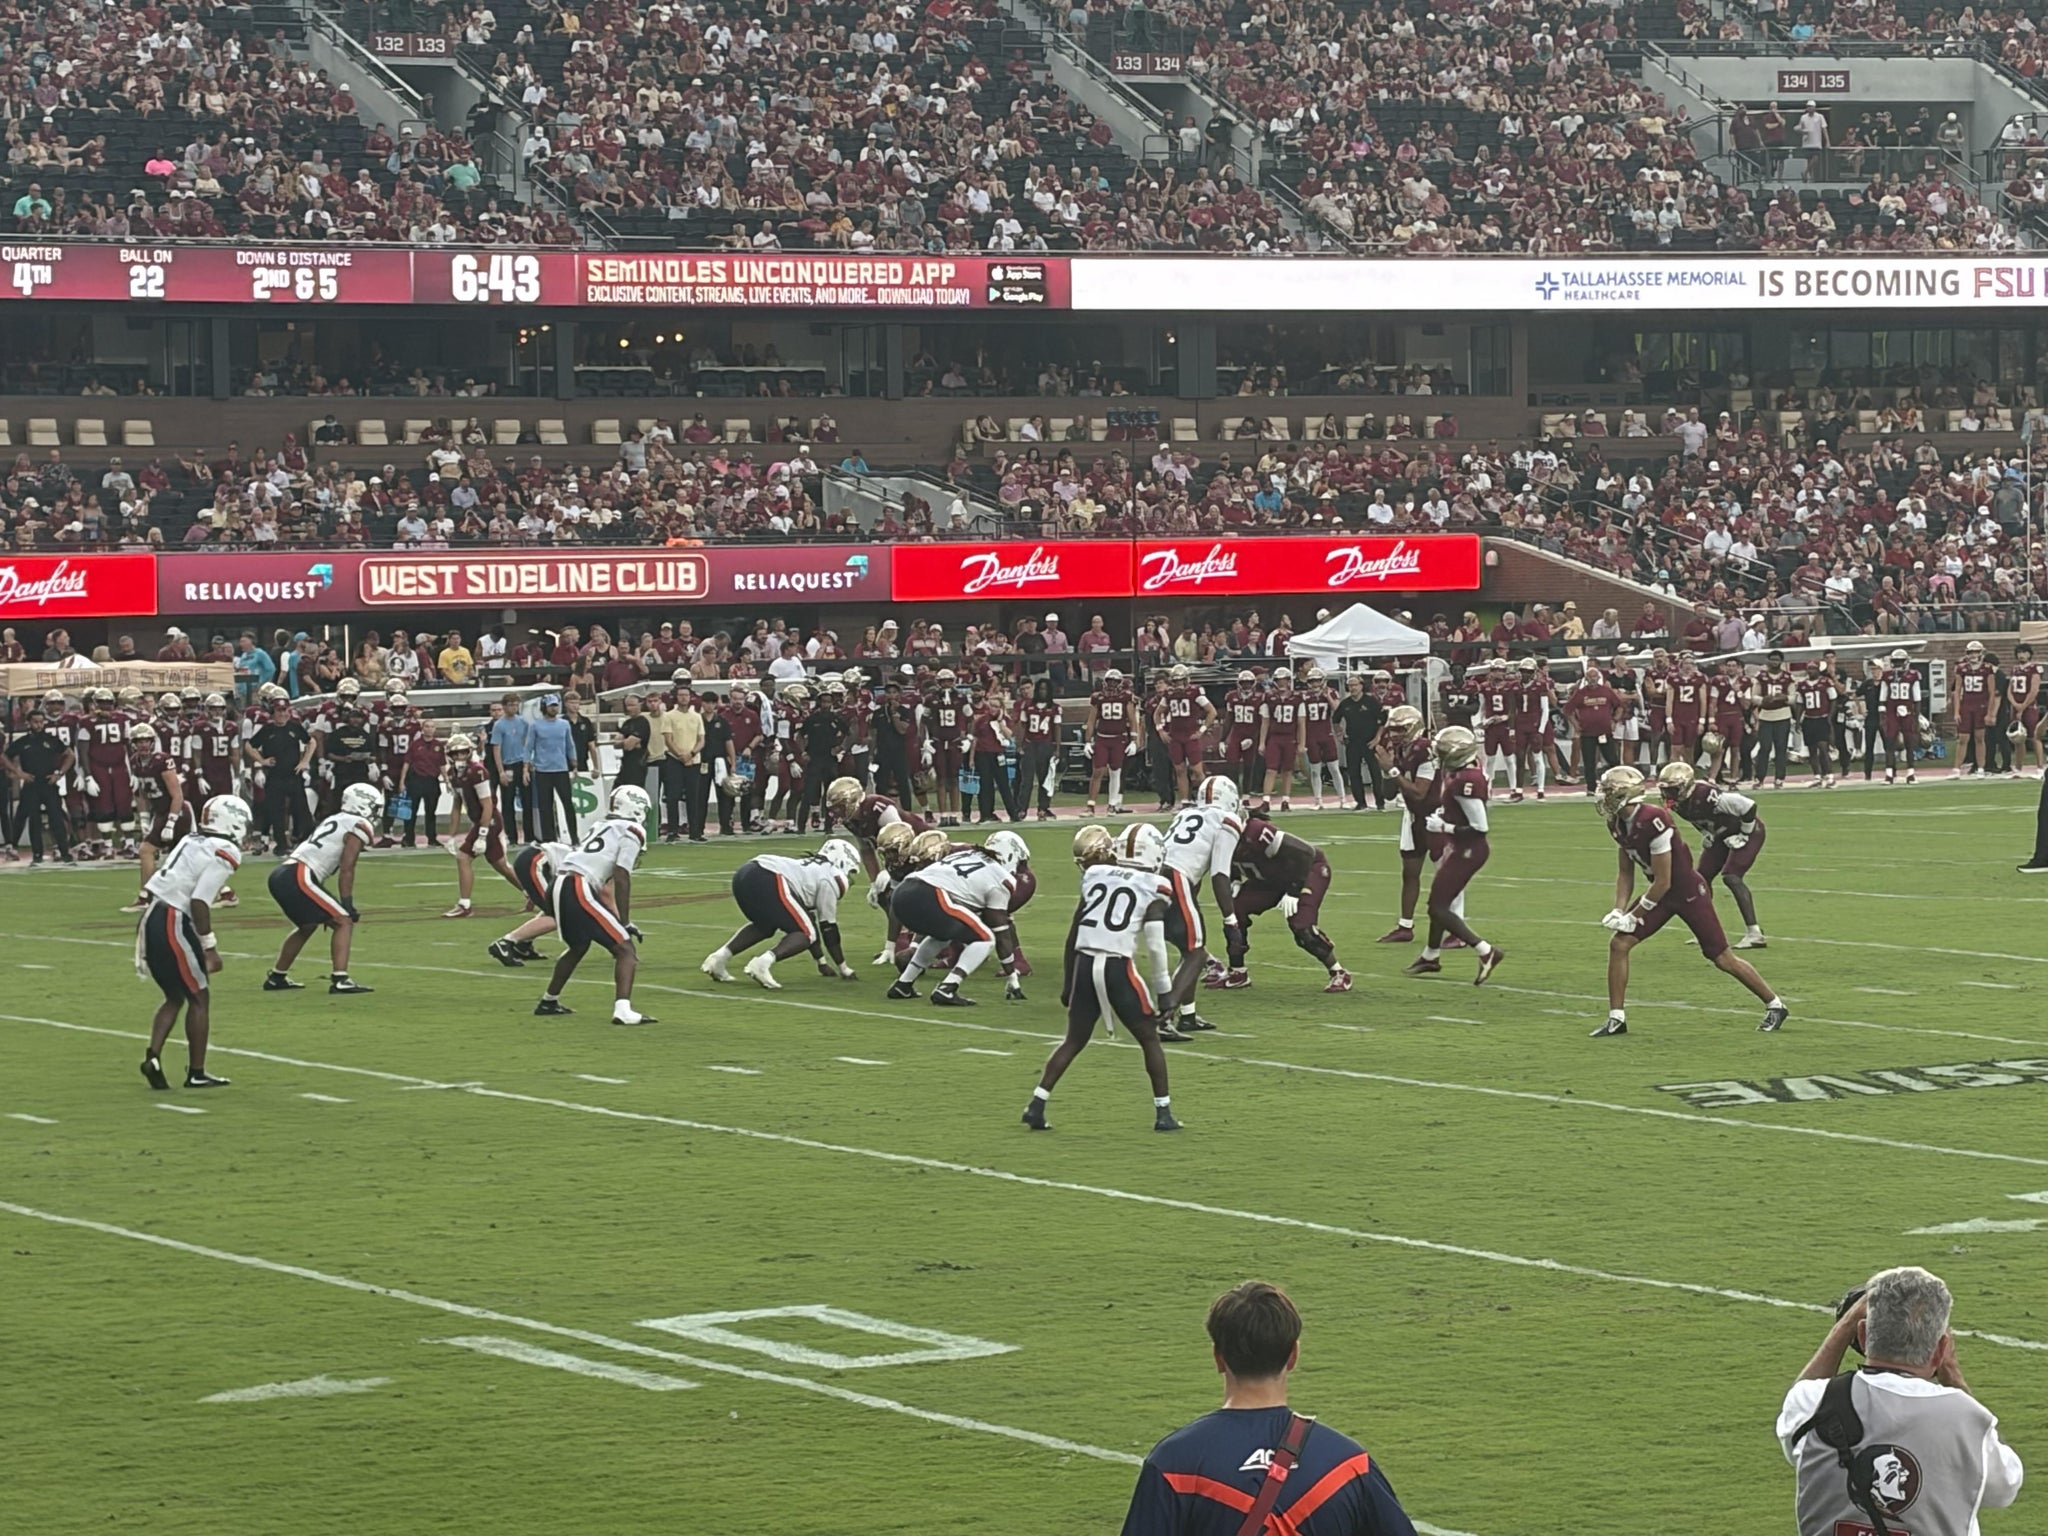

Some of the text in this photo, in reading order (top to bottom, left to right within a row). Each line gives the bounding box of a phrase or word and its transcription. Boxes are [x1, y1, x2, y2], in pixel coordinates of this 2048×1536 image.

[375, 36, 404, 52] 132
[417, 38, 446, 53] 133
[1115, 56, 1142, 71] 133
[1154, 56, 1181, 71] 134
[1782, 74, 1808, 88] 134
[1819, 74, 1846, 89] 135
[2, 246, 62, 262] QUARTER
[119, 249, 173, 263] BALL ON
[236, 251, 352, 267] DOWN & DISTANCE
[13, 262, 52, 296] 4TH
[129, 265, 165, 298] 22
[451, 255, 540, 303] 6:43
[587, 259, 956, 286] SEMINOLES UNCONQUERED APP
[1562, 271, 1747, 286] TALLAHASSEE MEMORIAL
[1759, 269, 1784, 297] IS
[1795, 268, 1960, 297] BECOMING
[1974, 266, 2035, 298] FSU
[253, 267, 338, 300] 2ND & 5
[587, 285, 644, 303] EXCLUSIVE
[646, 285, 695, 304] CONTENT,
[695, 286, 748, 305] STREAMS,
[749, 287, 773, 304] LIVE
[773, 287, 814, 306] EVENTS,
[815, 287, 837, 304] AND
[877, 288, 933, 305] DOWNLOAD
[935, 288, 970, 305] TODAY!
[1564, 289, 1640, 301] HEALTHCARE
[961, 546, 1060, 594] Danfoss
[1142, 543, 1238, 591] Danfoss
[1325, 540, 1421, 587] Danfoss
[370, 561, 697, 596] WEST SIDELINE CLUB
[734, 571, 855, 593] RELIAQUEST
[185, 579, 319, 603] RELIAQUEST
[36, 668, 209, 689] FLORIDA STATE
[1679, 685, 1695, 703] 12
[1725, 690, 1736, 705] 4
[1101, 702, 1123, 720] 89
[1273, 704, 1294, 724] 48
[94, 722, 121, 744] 79
[1029, 714, 1050, 735] 84
[212, 735, 229, 757] 15
[1080, 882, 1137, 932] 20
